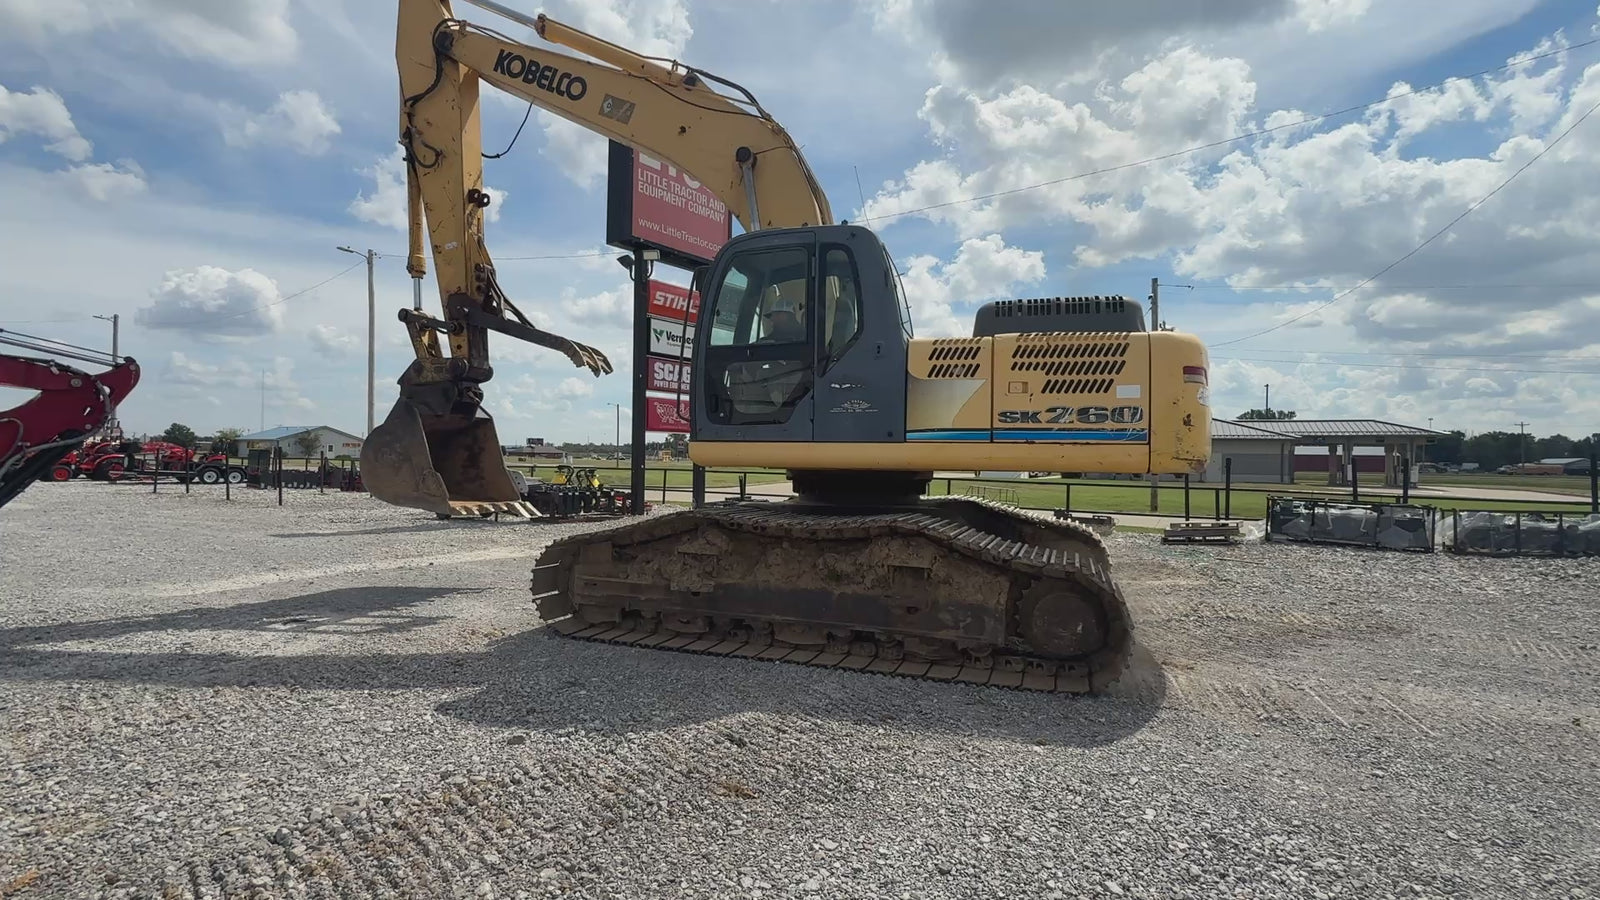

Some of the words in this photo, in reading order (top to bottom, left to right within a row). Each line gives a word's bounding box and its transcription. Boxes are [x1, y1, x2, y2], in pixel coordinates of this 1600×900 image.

[493, 49, 587, 101] KOBELCO
[638, 168, 668, 190] LITTLE
[670, 180, 708, 205] TRACTOR
[709, 198, 725, 213] AND
[638, 181, 686, 209] EQUIPMENT
[688, 201, 725, 224] COMPANY
[997, 405, 1143, 424] SK260
